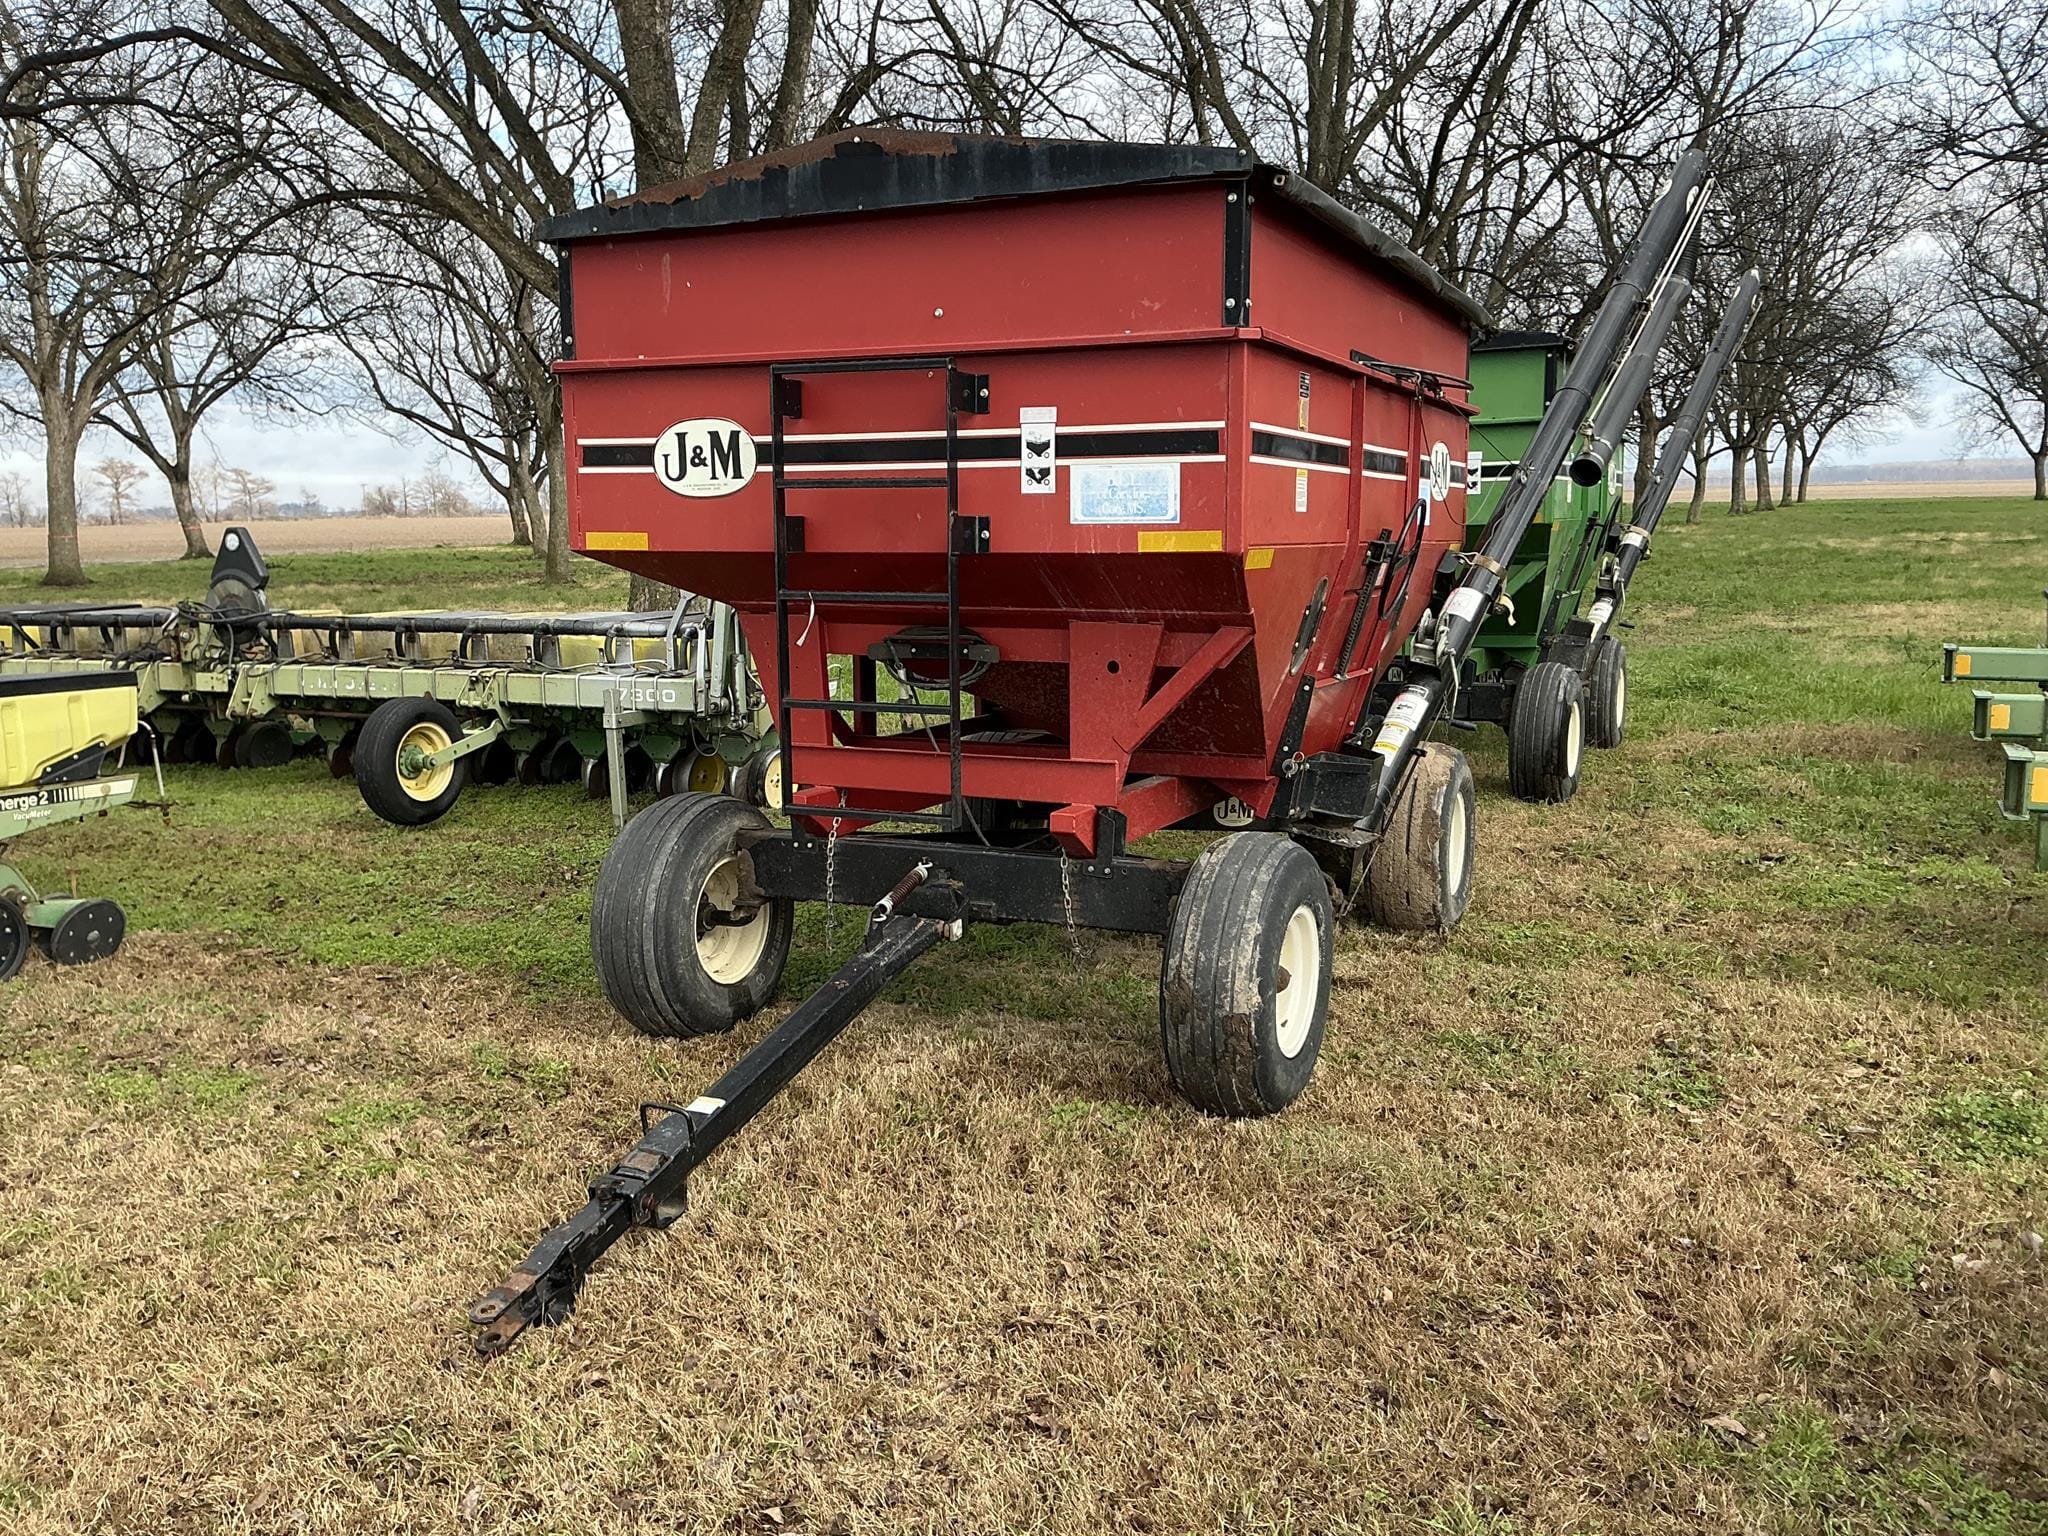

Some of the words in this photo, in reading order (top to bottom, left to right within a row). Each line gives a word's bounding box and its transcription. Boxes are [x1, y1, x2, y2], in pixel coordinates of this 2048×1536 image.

[661, 430, 745, 482] J&M
[619, 687, 676, 703] 7300
[1216, 798, 1252, 819] J&M
